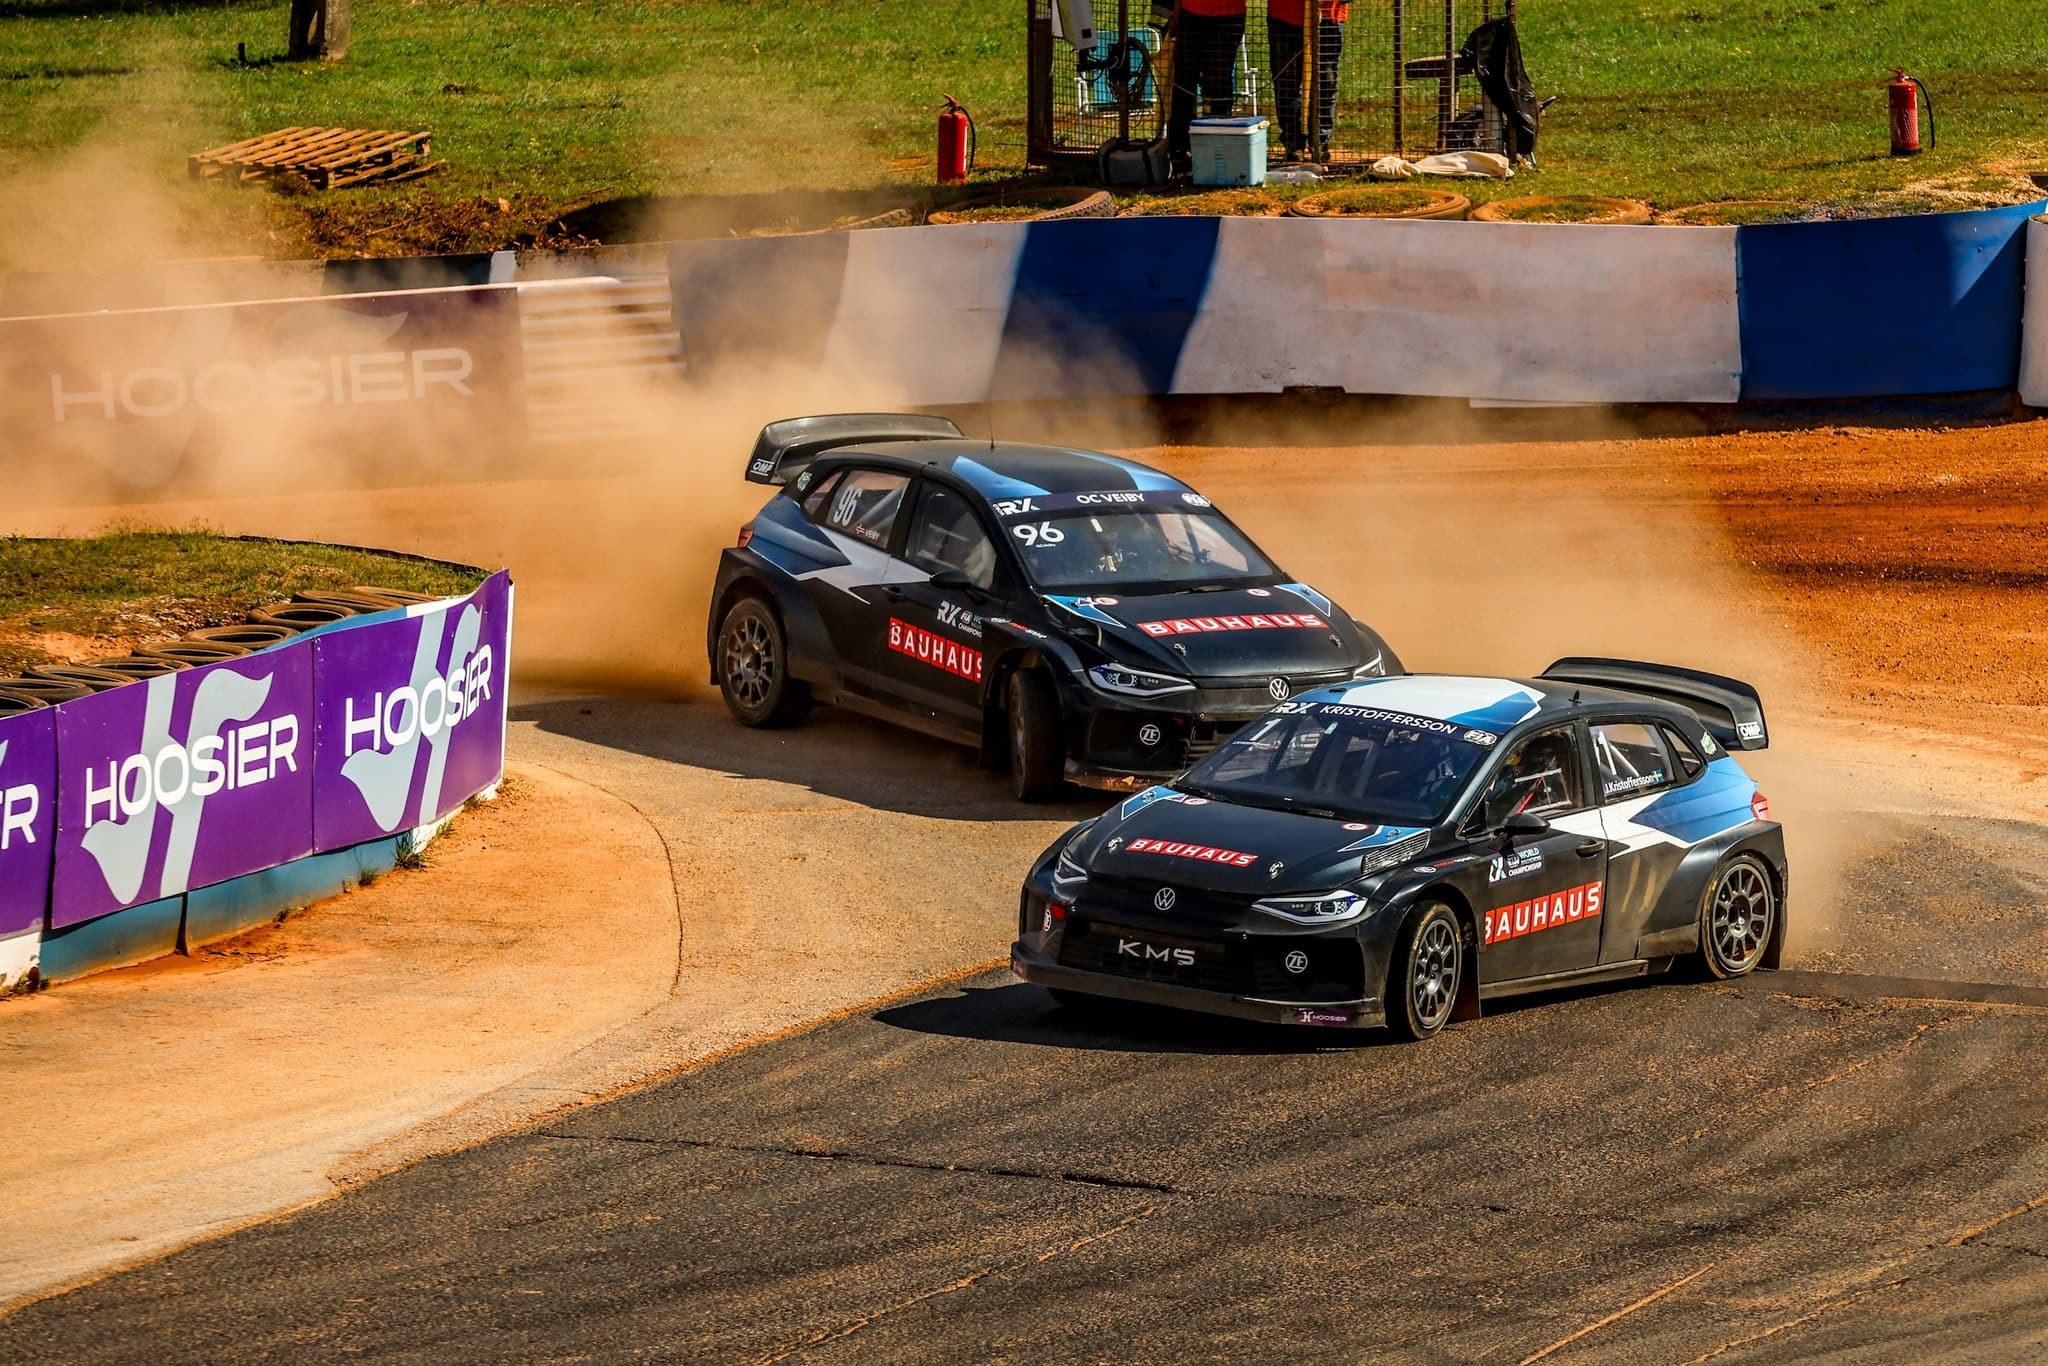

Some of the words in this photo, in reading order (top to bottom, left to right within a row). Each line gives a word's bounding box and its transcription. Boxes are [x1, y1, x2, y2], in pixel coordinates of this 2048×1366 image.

[51, 348, 473, 423] HOOSIER
[834, 485, 863, 526] 96
[1076, 494, 1100, 504] OC
[1101, 493, 1145, 502] VEIBY
[1013, 521, 1065, 546] 96
[1147, 614, 1323, 634] BAUHAUS
[345, 643, 492, 757] HOOSIER
[1249, 718, 1282, 741] 1
[1320, 704, 1457, 734] KRISTOFFERSSON
[1740, 724, 1760, 737] OMP
[1598, 731, 1617, 776] 1
[84, 713, 299, 828] HOOSIER
[0, 783, 39, 850] R
[1131, 839, 1255, 865] BAUHAUS
[1119, 938, 1196, 966] KMS
[1312, 1014, 1347, 1022] HOOSIER
